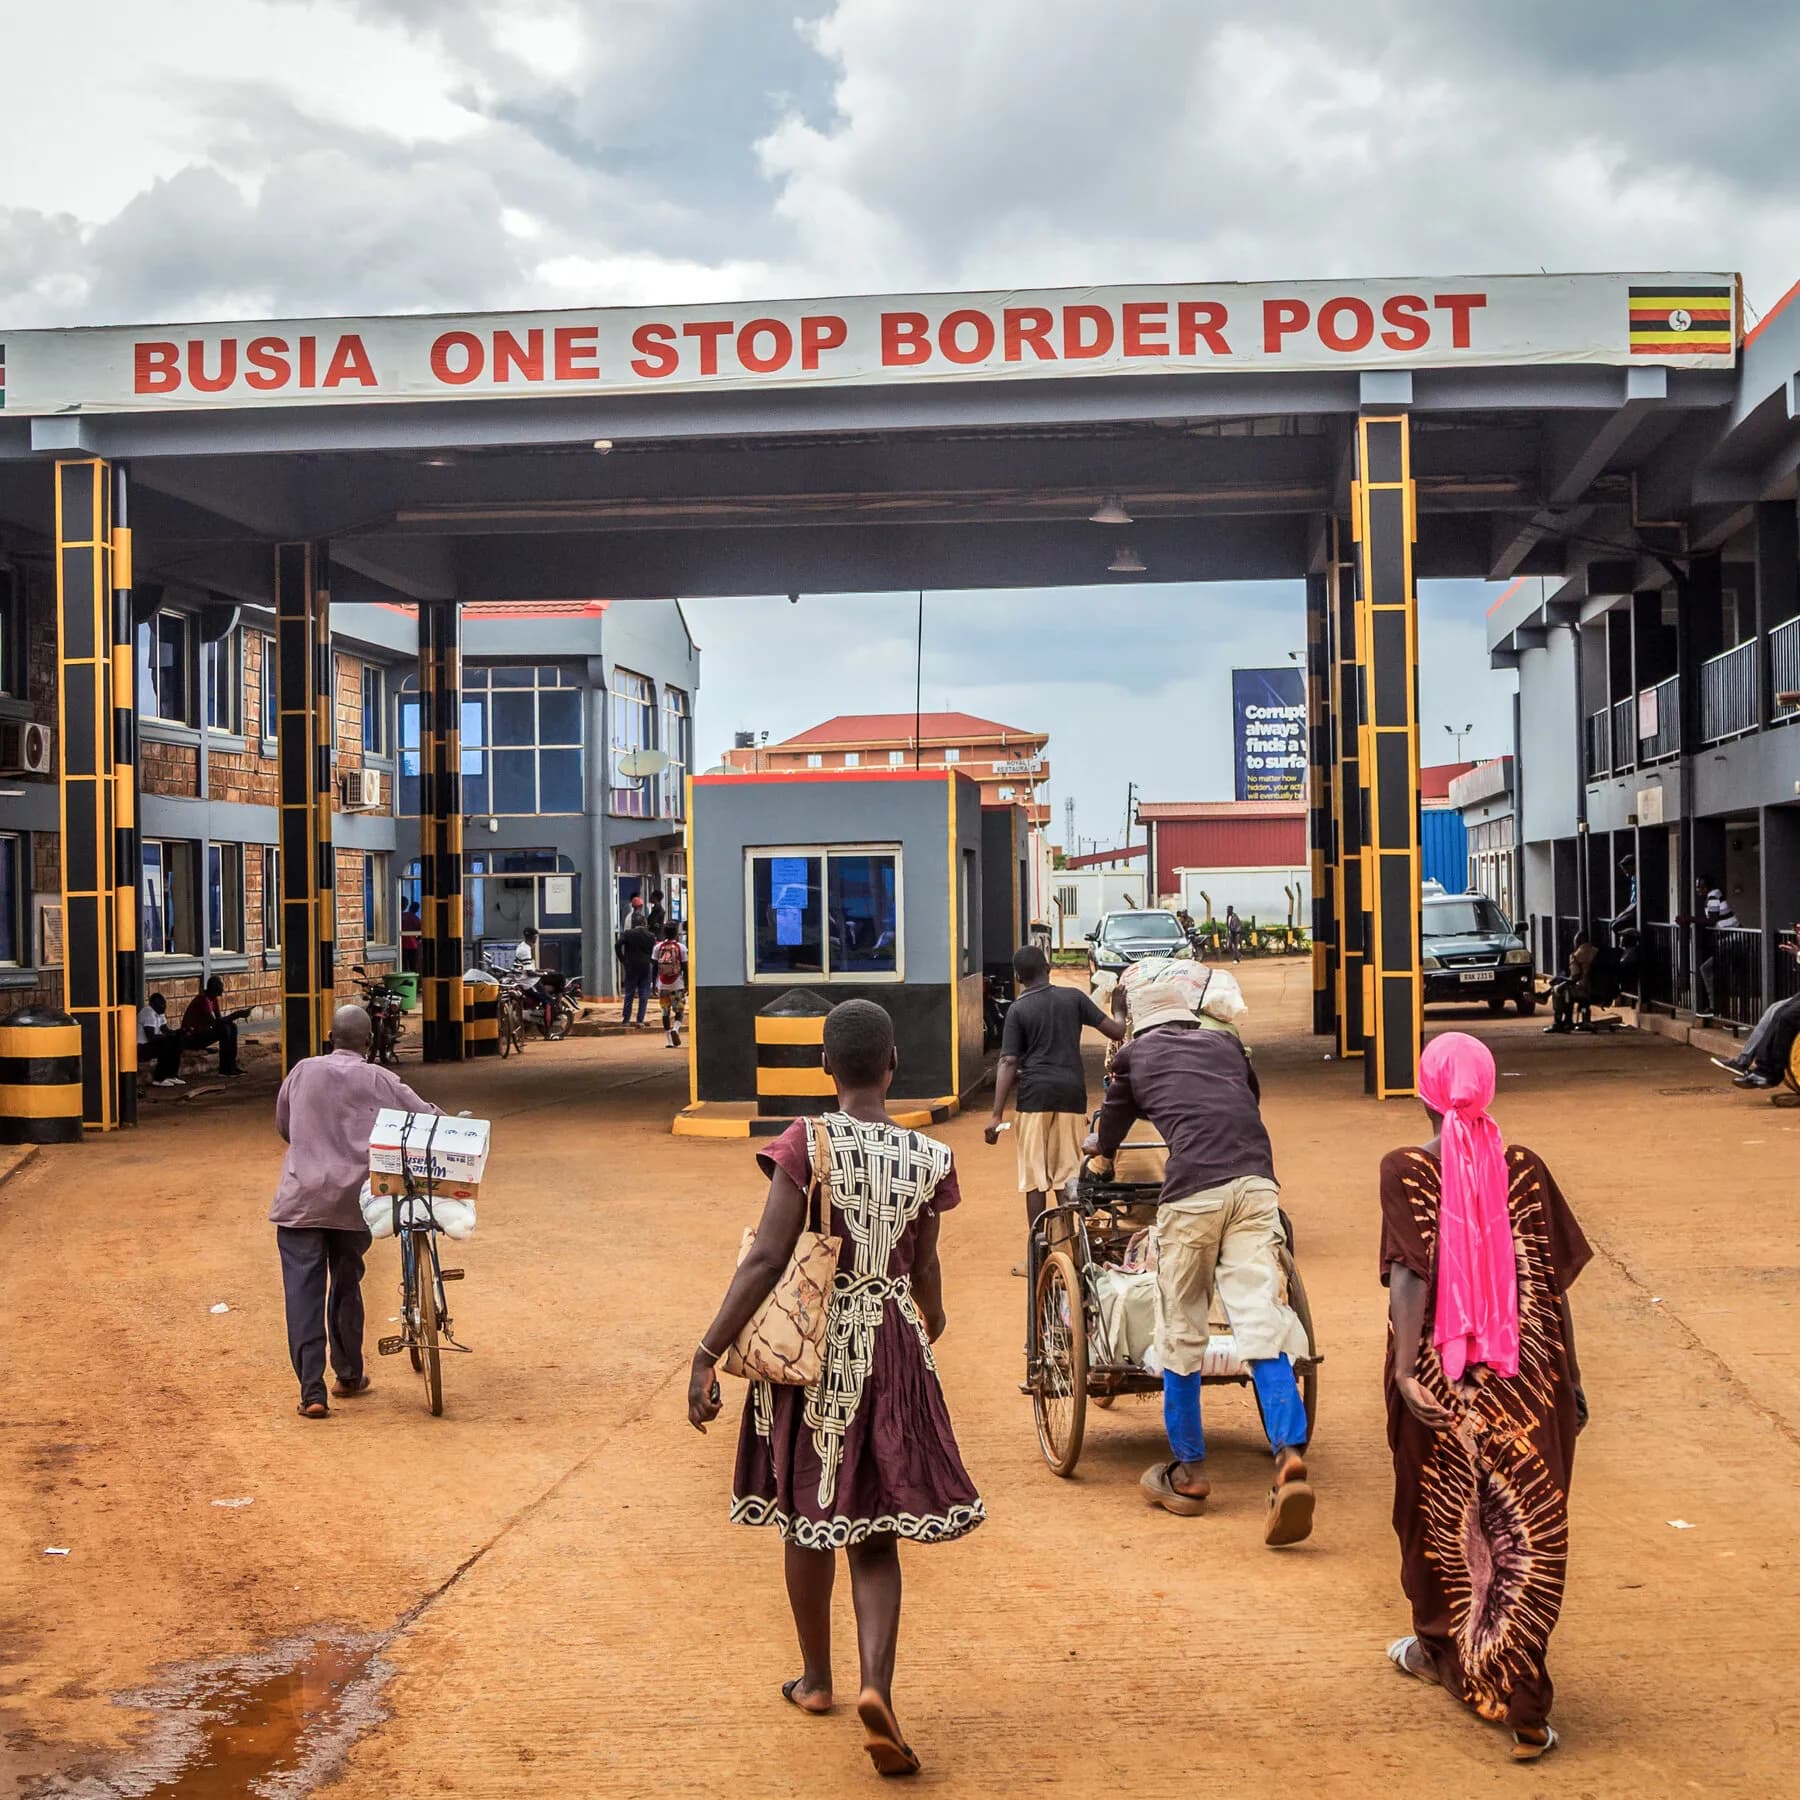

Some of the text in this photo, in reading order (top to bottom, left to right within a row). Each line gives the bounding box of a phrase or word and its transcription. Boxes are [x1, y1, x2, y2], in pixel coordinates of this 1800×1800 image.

[135, 294, 1486, 394] BUSIA ONE STOP BORDER POST
[1246, 705, 1306, 720] Corrupt
[1246, 721, 1299, 737] always
[1247, 738, 1286, 752] finds
[1288, 740, 1299, 752] a
[1247, 754, 1306, 768] to surfa
[1273, 784, 1290, 792] your
[412, 1166, 447, 1178] Wite
